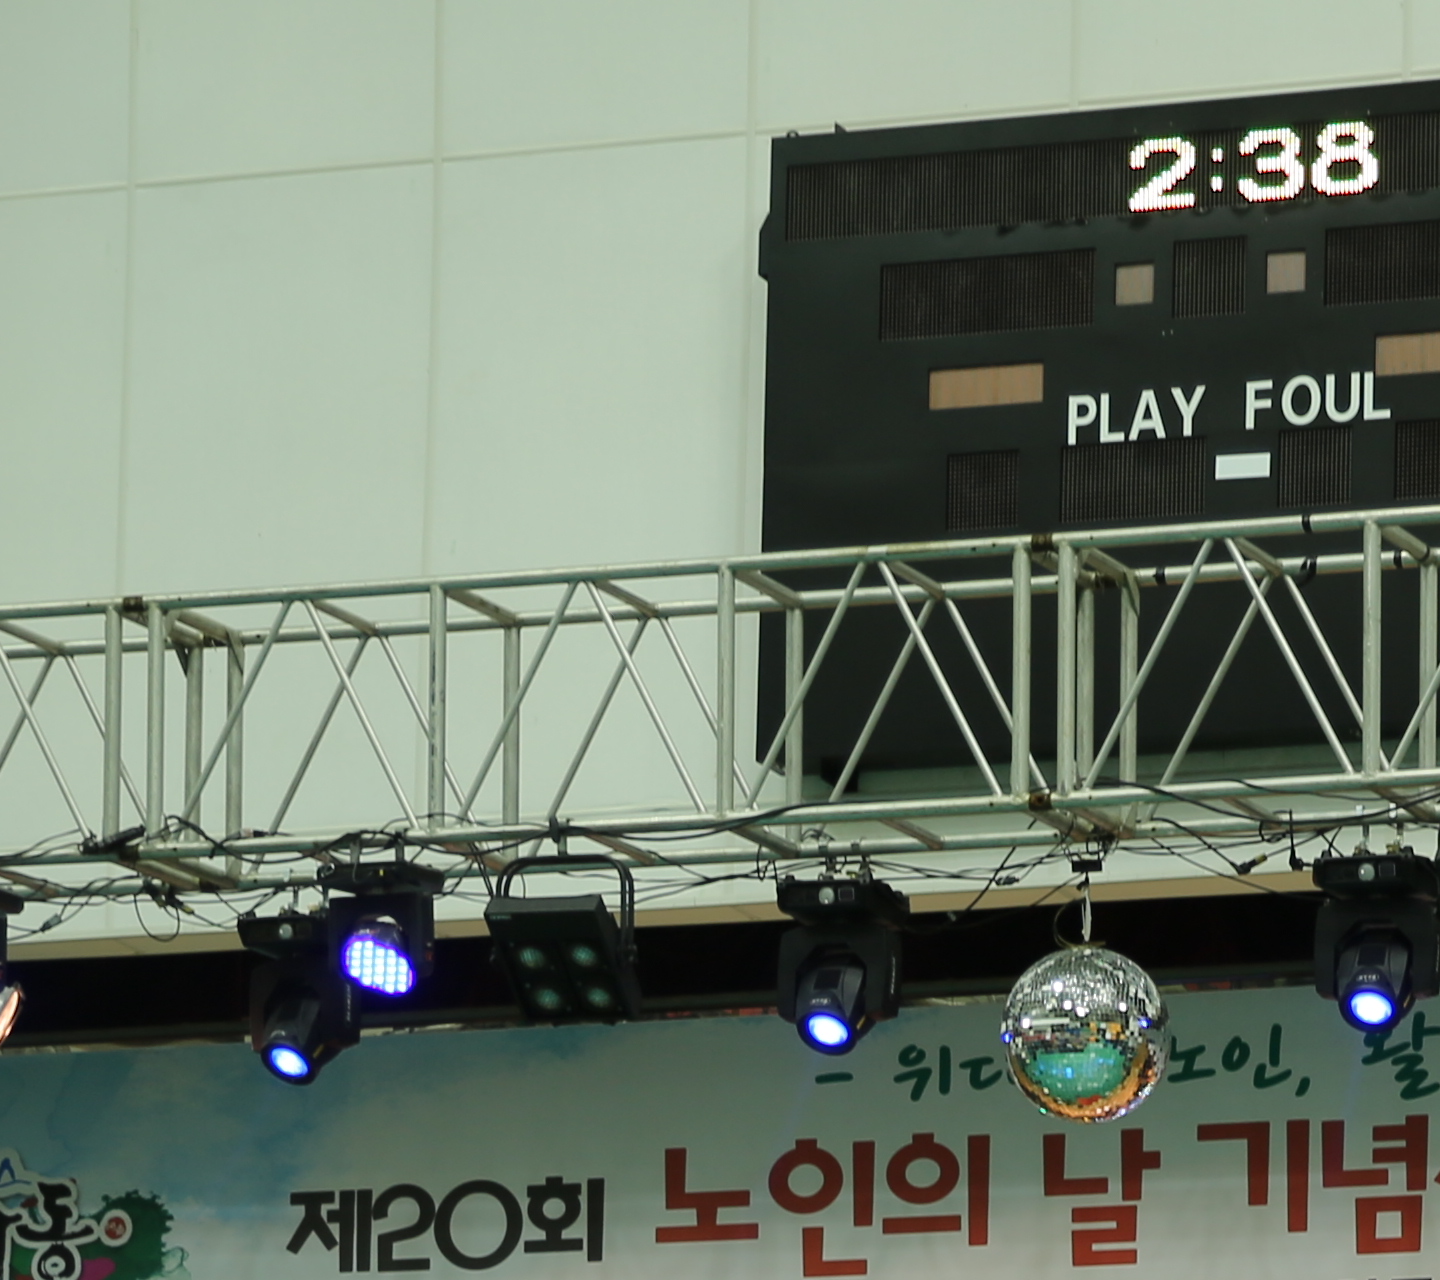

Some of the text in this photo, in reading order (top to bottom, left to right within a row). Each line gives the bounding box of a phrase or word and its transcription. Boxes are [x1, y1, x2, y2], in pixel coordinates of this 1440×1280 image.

[1128, 120, 1380, 213] 2:38
[1067, 371, 1393, 446] PLAY FOUL
[286, 1175, 605, 1273] 제20회
[655, 1132, 991, 1278] 노인의
[1043, 1128, 1162, 1267] 날
